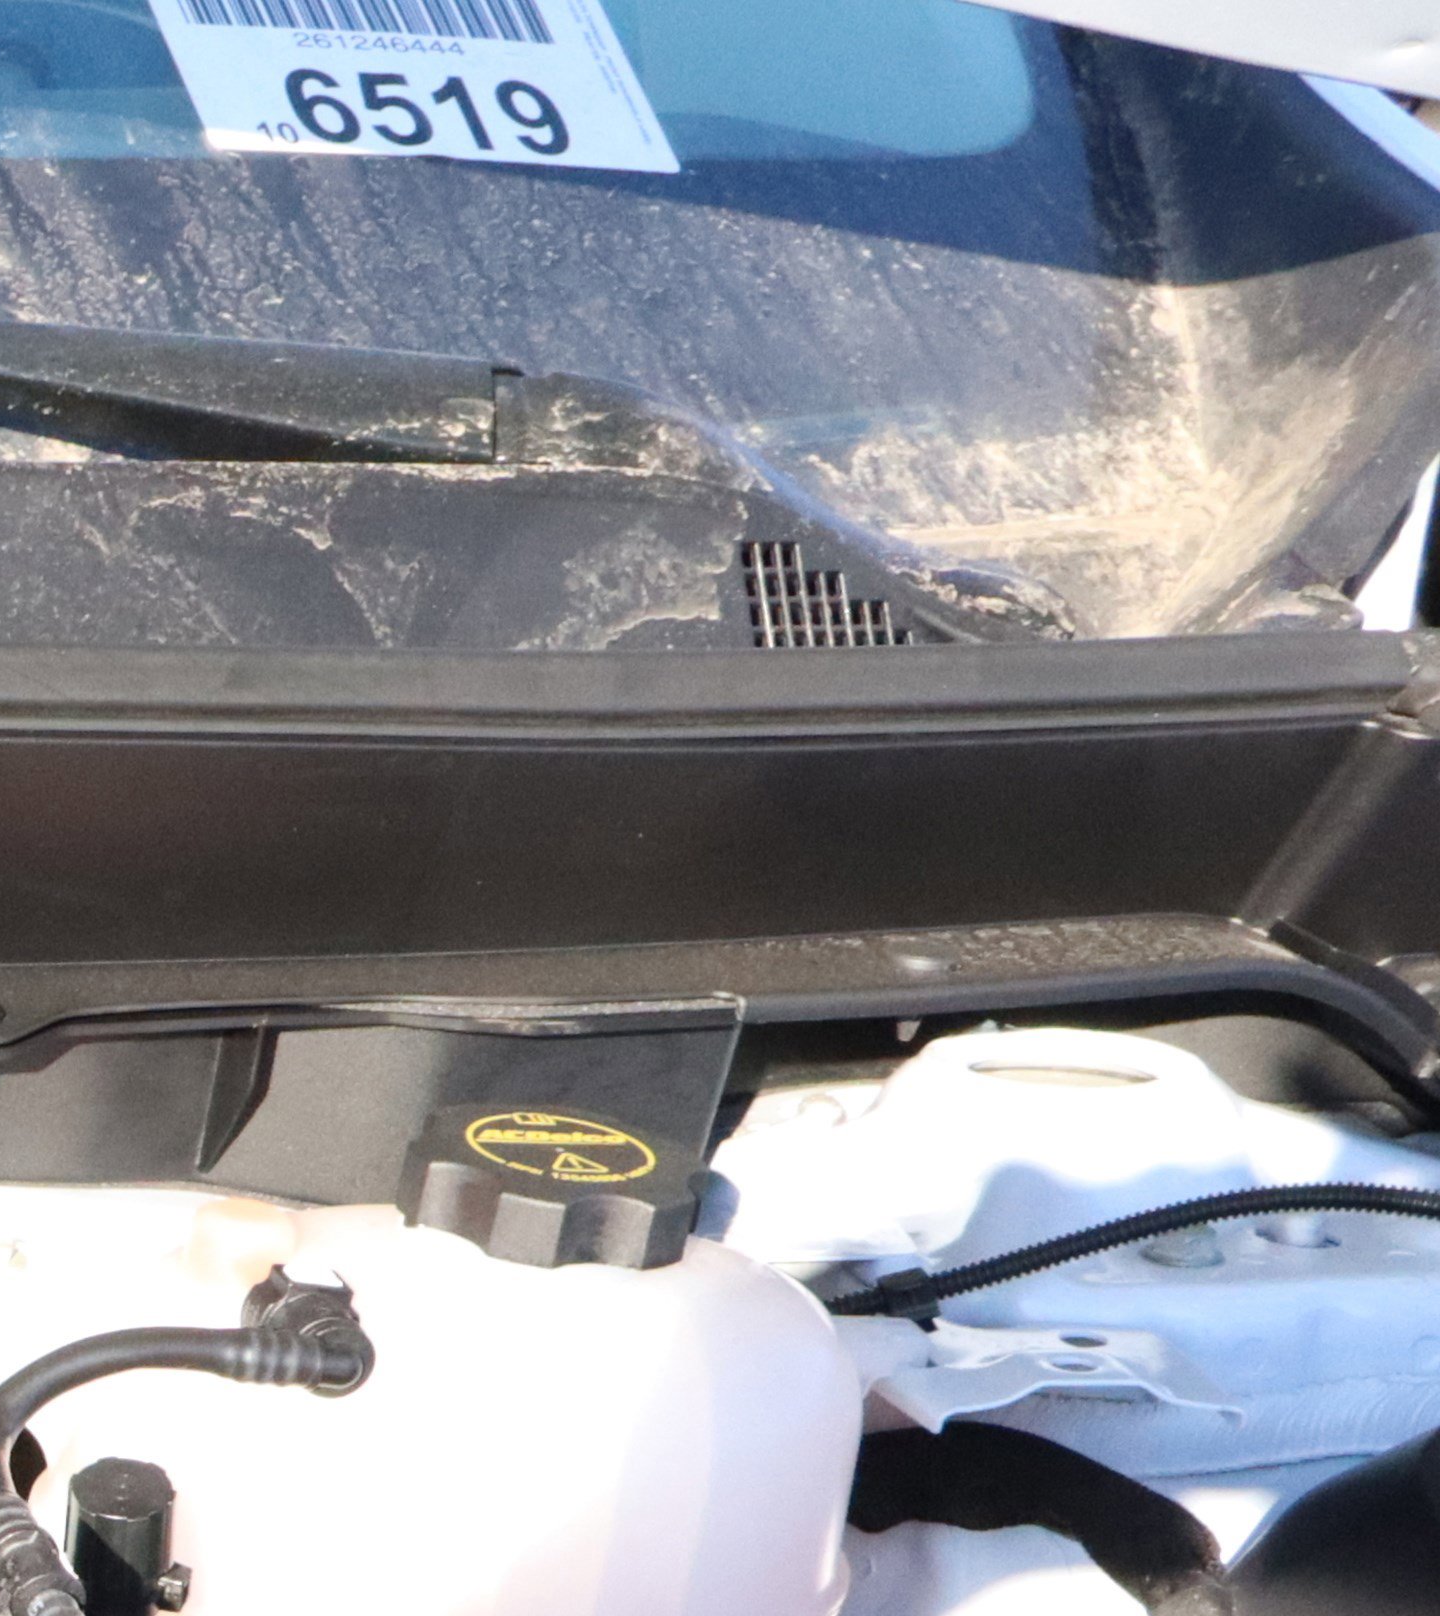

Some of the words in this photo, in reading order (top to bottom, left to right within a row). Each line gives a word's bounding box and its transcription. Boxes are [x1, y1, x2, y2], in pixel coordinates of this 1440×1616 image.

[293, 31, 466, 56] 261246444
[257, 122, 300, 144] 10
[284, 67, 572, 157] 6519
[476, 1129, 628, 1145] ACDelco
